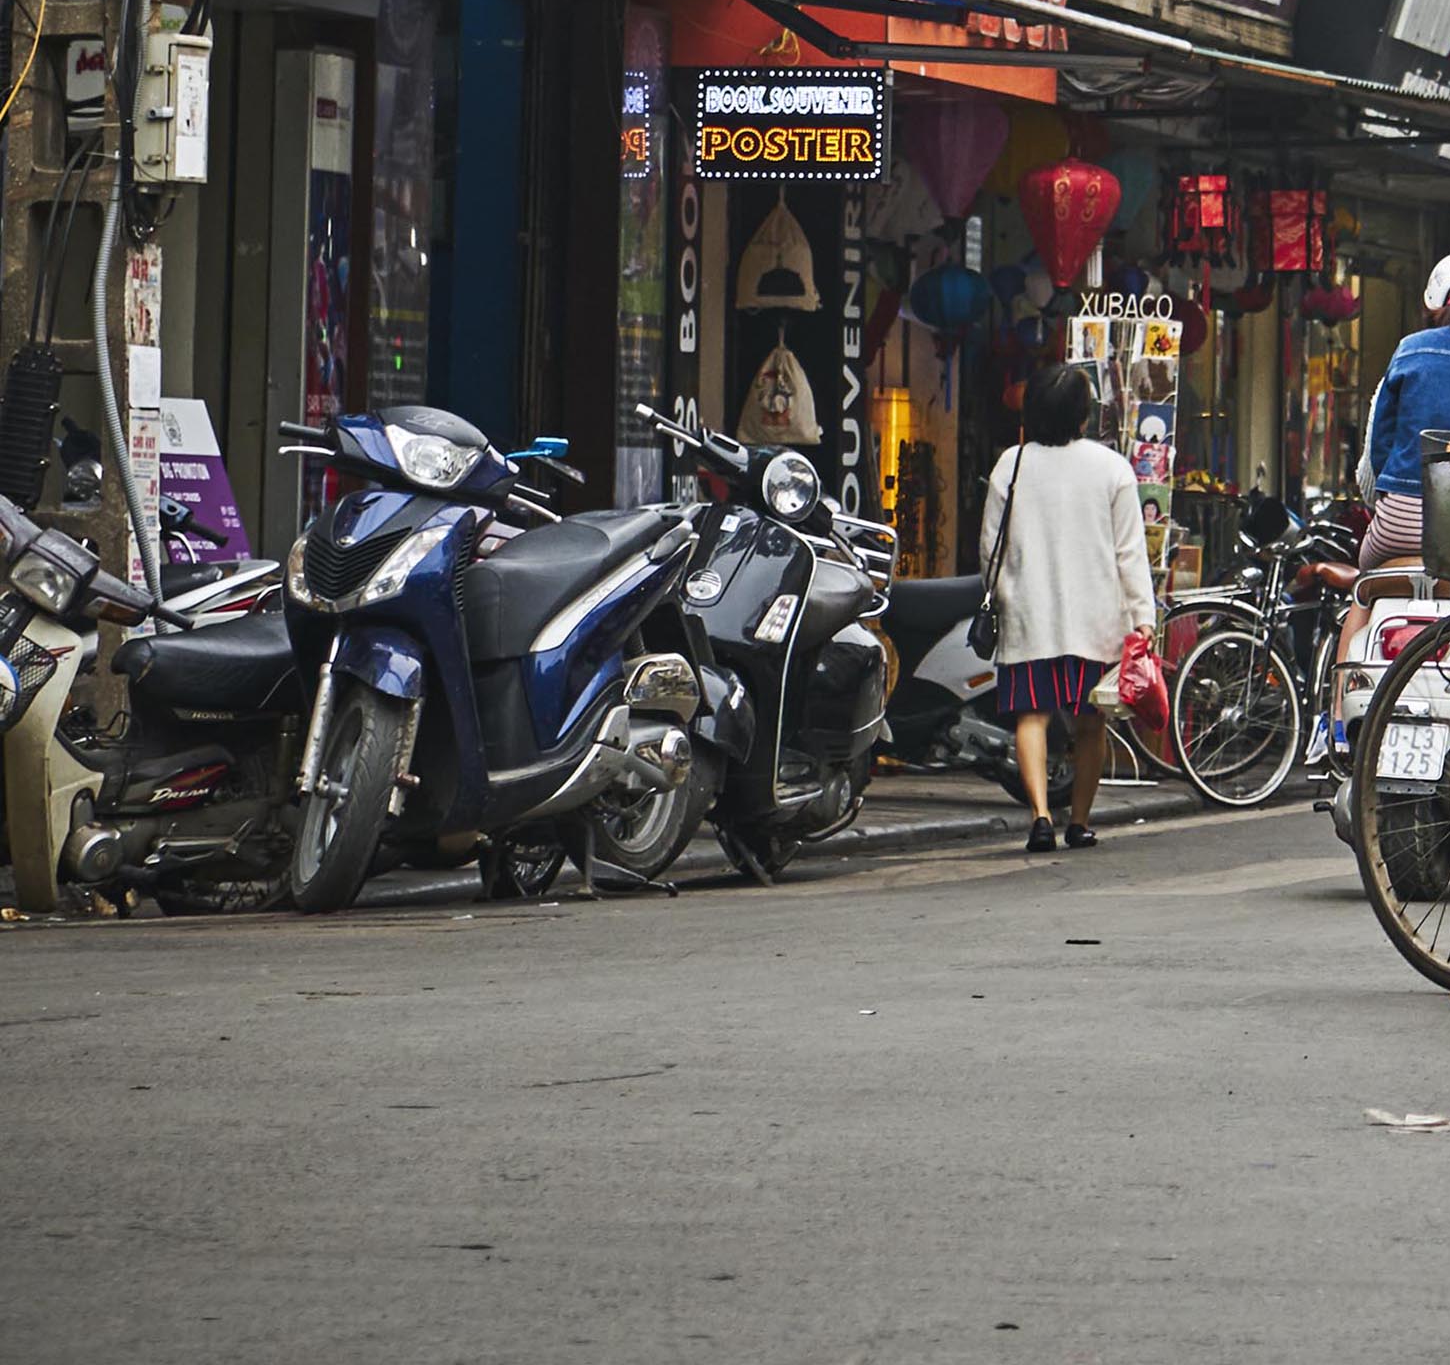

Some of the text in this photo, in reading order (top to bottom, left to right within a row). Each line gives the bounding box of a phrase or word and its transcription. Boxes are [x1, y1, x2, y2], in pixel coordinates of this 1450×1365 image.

[702, 127, 874, 162] POSTER
[1078, 292, 1174, 320] XUBACO
[1381, 724, 1434, 750] 0-L3
